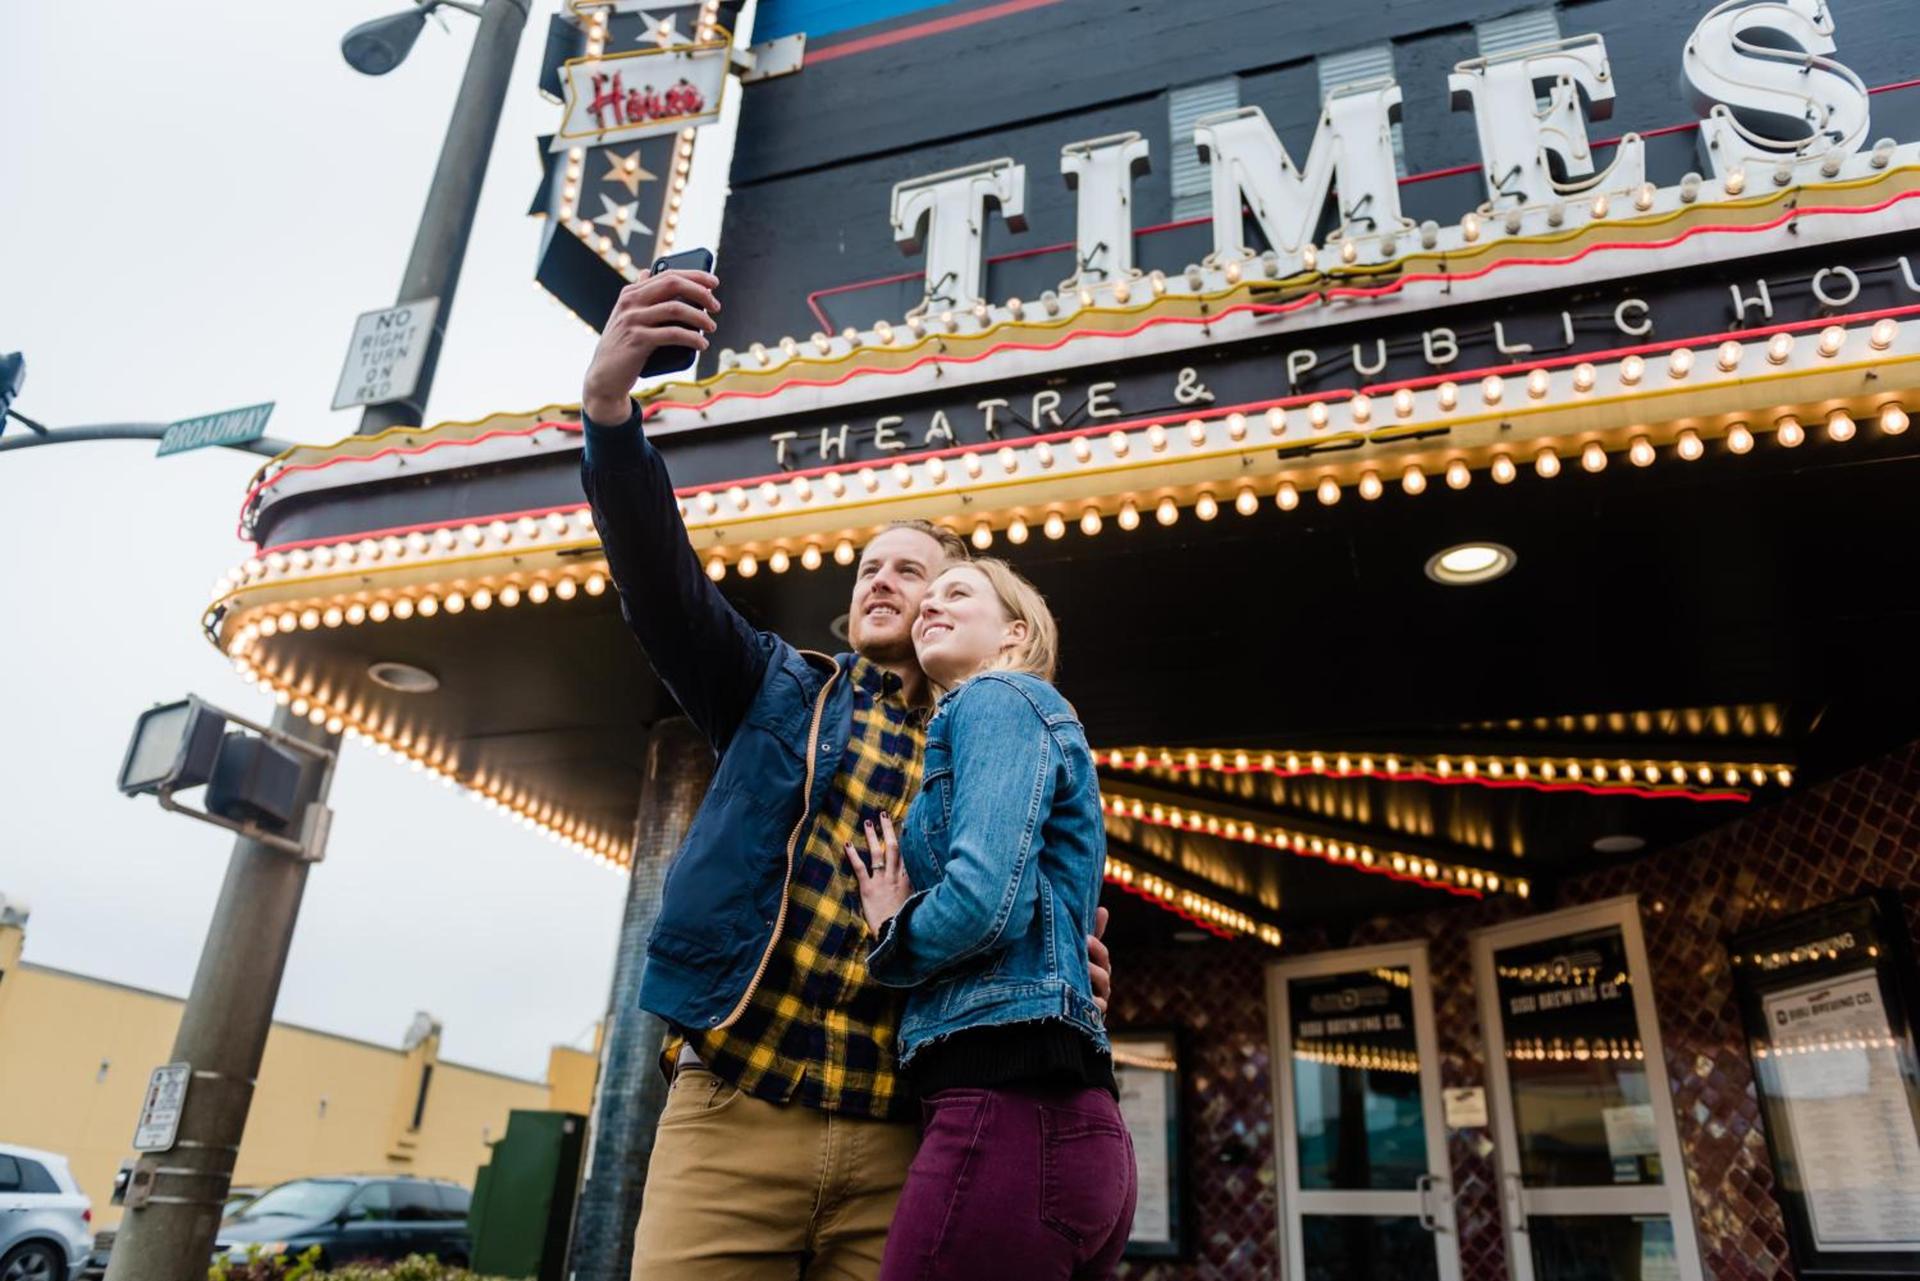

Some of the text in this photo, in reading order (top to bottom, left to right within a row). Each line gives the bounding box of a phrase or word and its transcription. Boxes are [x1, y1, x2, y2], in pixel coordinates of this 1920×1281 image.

[587, 70, 704, 126] House
[891, 0, 1870, 322] TIMES
[377, 309, 411, 329] NO
[361, 327, 416, 351] RIGHT
[361, 345, 409, 367] TURN
[365, 364, 394, 383] ON
[770, 382, 1121, 466] THEATRE
[1174, 367, 1214, 403] &
[1287, 299, 1653, 384] PUBLIC
[354, 381, 391, 401] RED
[159, 405, 271, 452] BROADWAY
